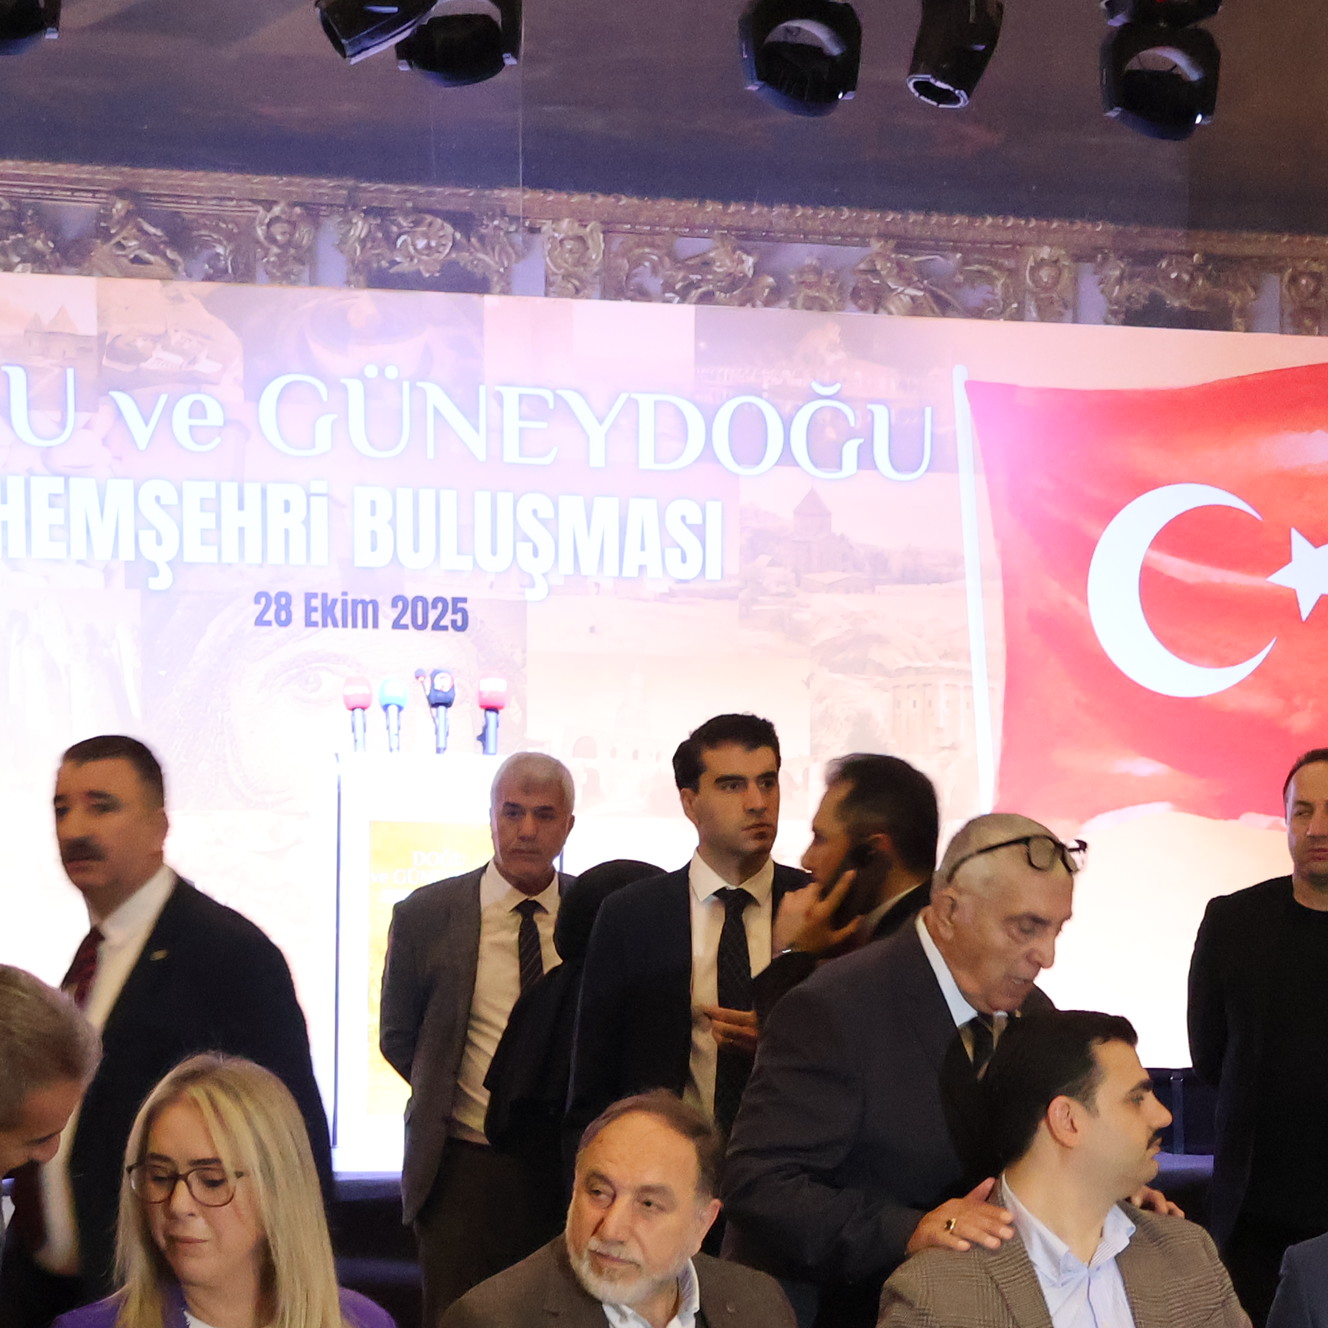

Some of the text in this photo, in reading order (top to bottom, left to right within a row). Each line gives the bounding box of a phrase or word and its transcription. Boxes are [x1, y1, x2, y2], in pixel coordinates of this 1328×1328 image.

[108, 389, 225, 453] ve
[257, 363, 933, 482] GÜNEYDOĞU
[351, 484, 723, 602] BULUŞMASI
[253, 591, 469, 633] 28 Ekim 2025
